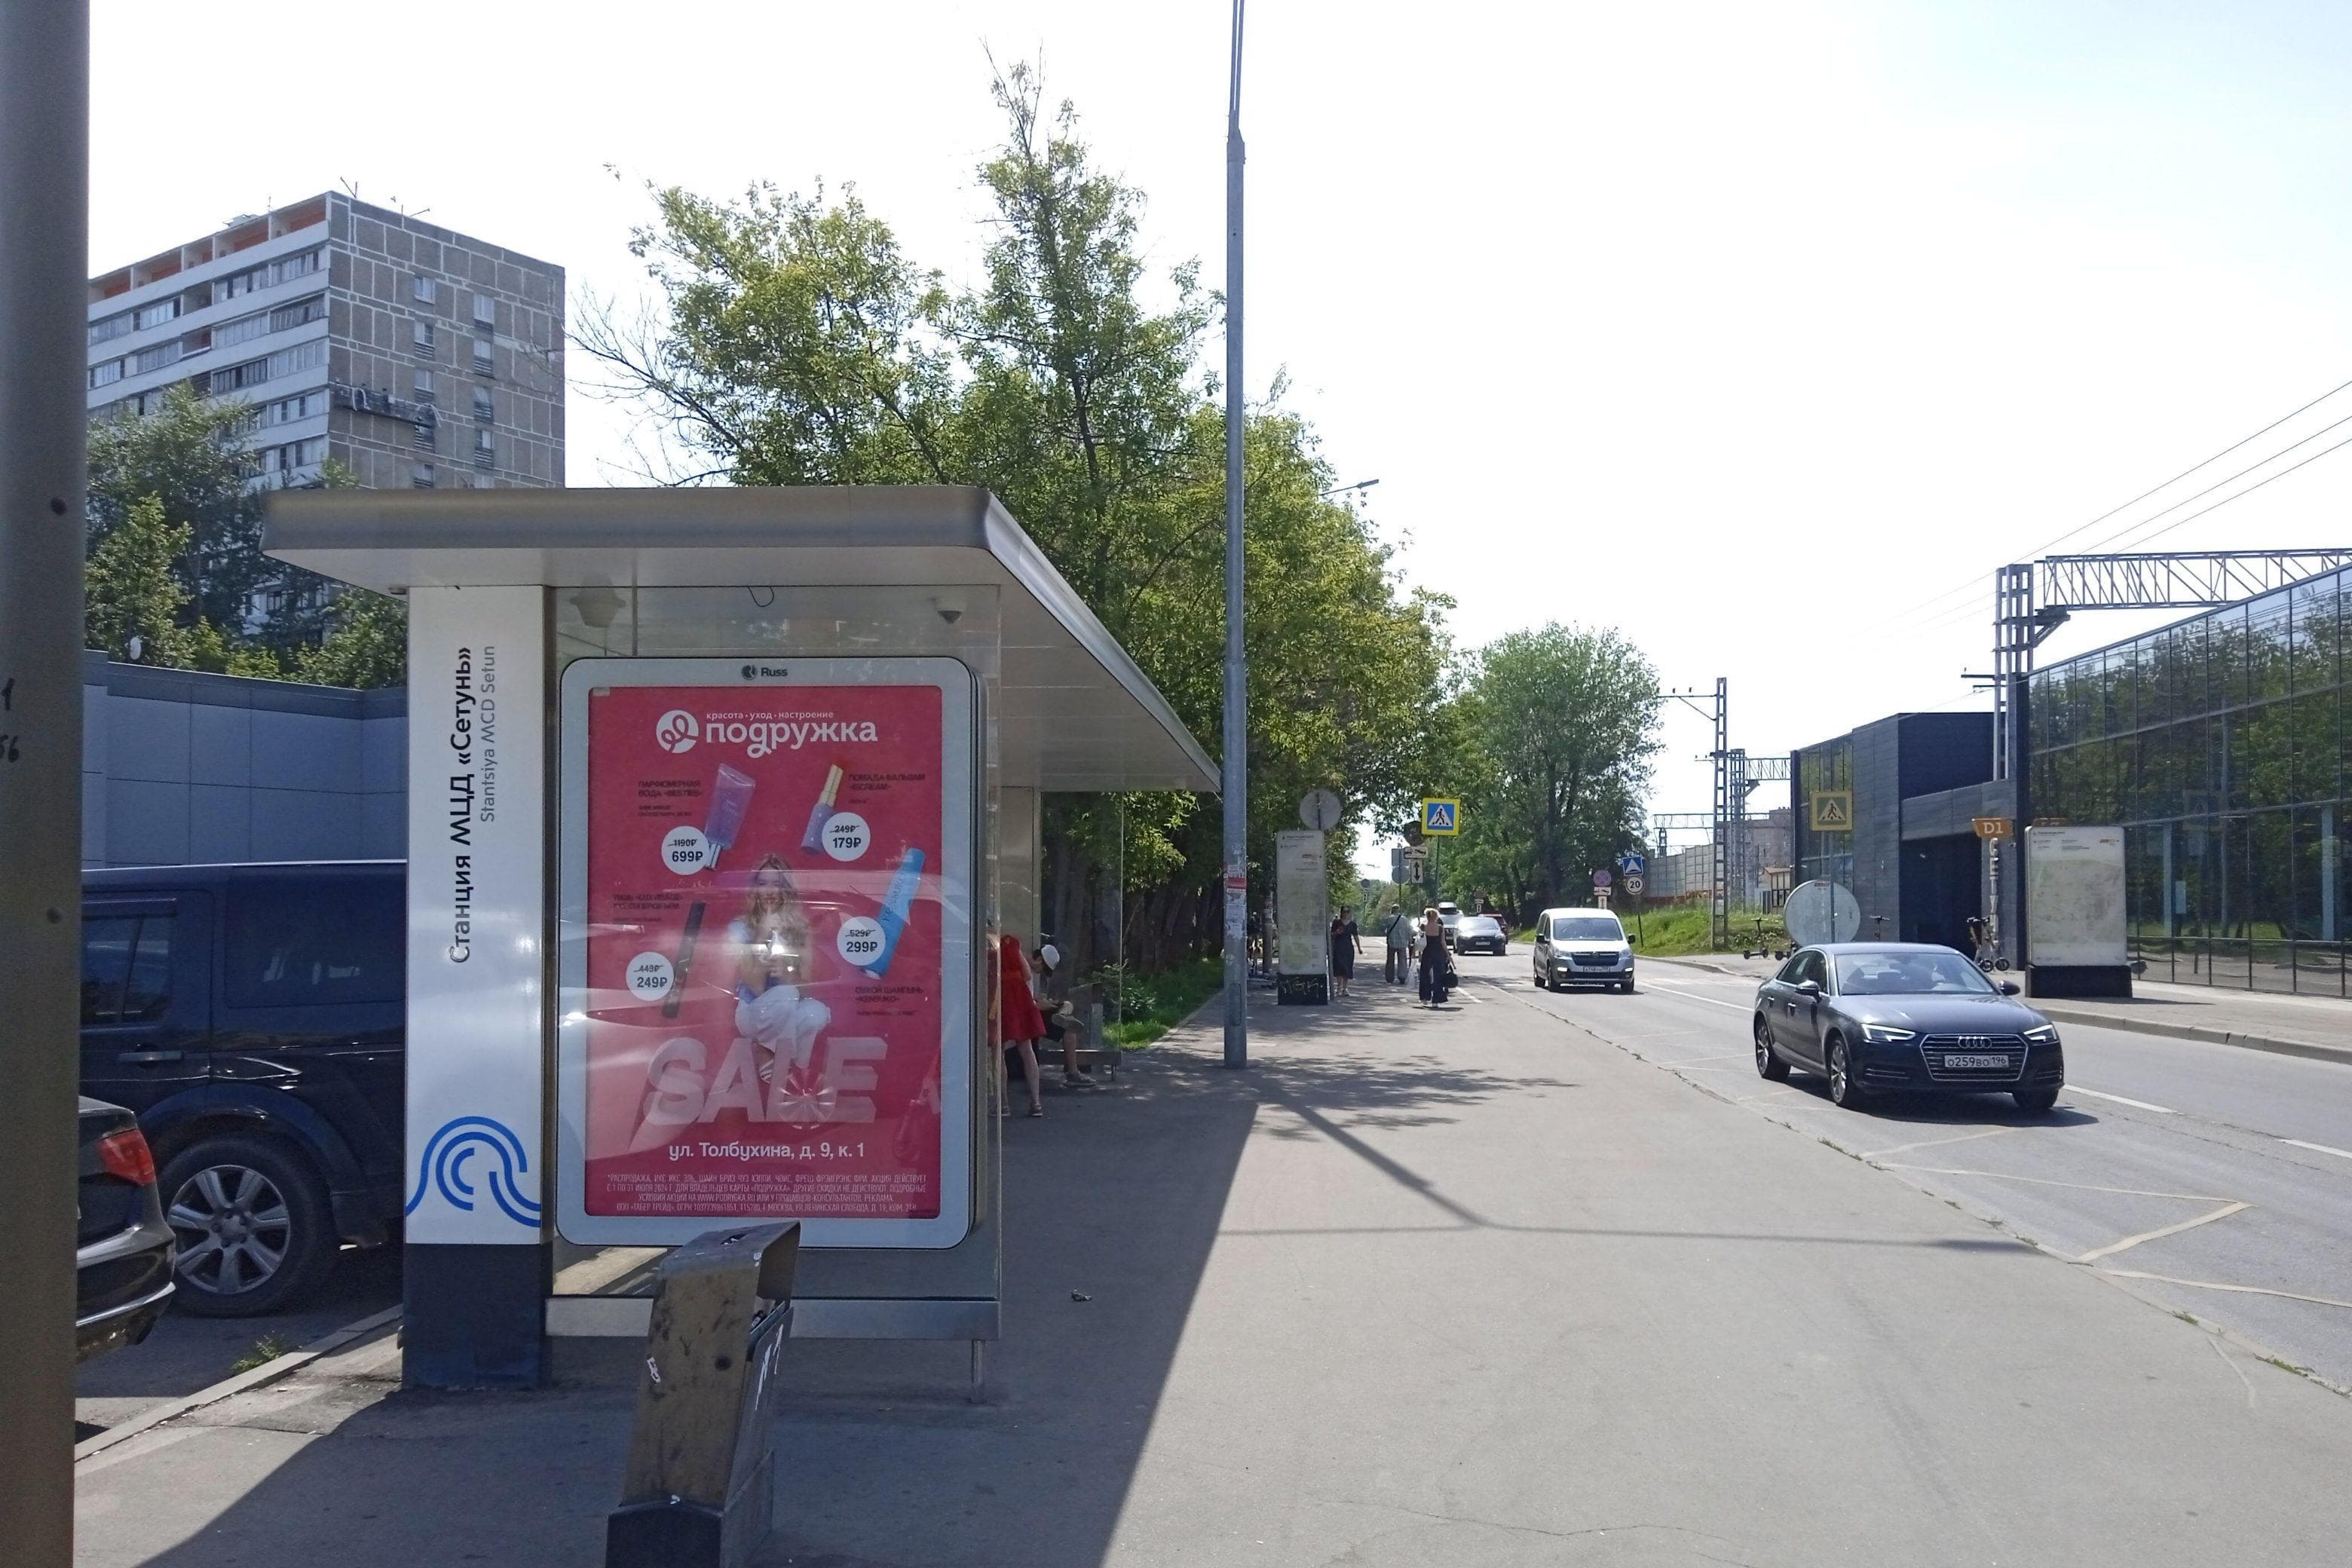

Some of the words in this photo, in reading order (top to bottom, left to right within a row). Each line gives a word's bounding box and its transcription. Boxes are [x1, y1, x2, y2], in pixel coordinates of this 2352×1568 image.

[480, 645, 495, 694] Setun
[761, 666, 789, 678] Russ
[450, 647, 476, 766] «Сетунь»
[480, 698, 495, 745] MCD
[706, 712, 744, 721] красота
[749, 711, 773, 721] уход
[778, 711, 835, 719] настроение
[706, 718, 878, 758] подружка
[480, 748, 495, 822] Stantsiya
[449, 773, 475, 847] МЦД
[1983, 822, 2004, 835] D1
[1629, 880, 1640, 889] 20
[449, 854, 475, 964] Станция
[642, 1036, 888, 1124] SALE
[669, 1145, 694, 1162] ул.
[699, 1141, 795, 1162] Толбухина,
[799, 1145, 816, 1159] д.
[820, 1143, 835, 1160] 9,
[839, 1146, 854, 1158] к.
[857, 1143, 865, 1158] 1
